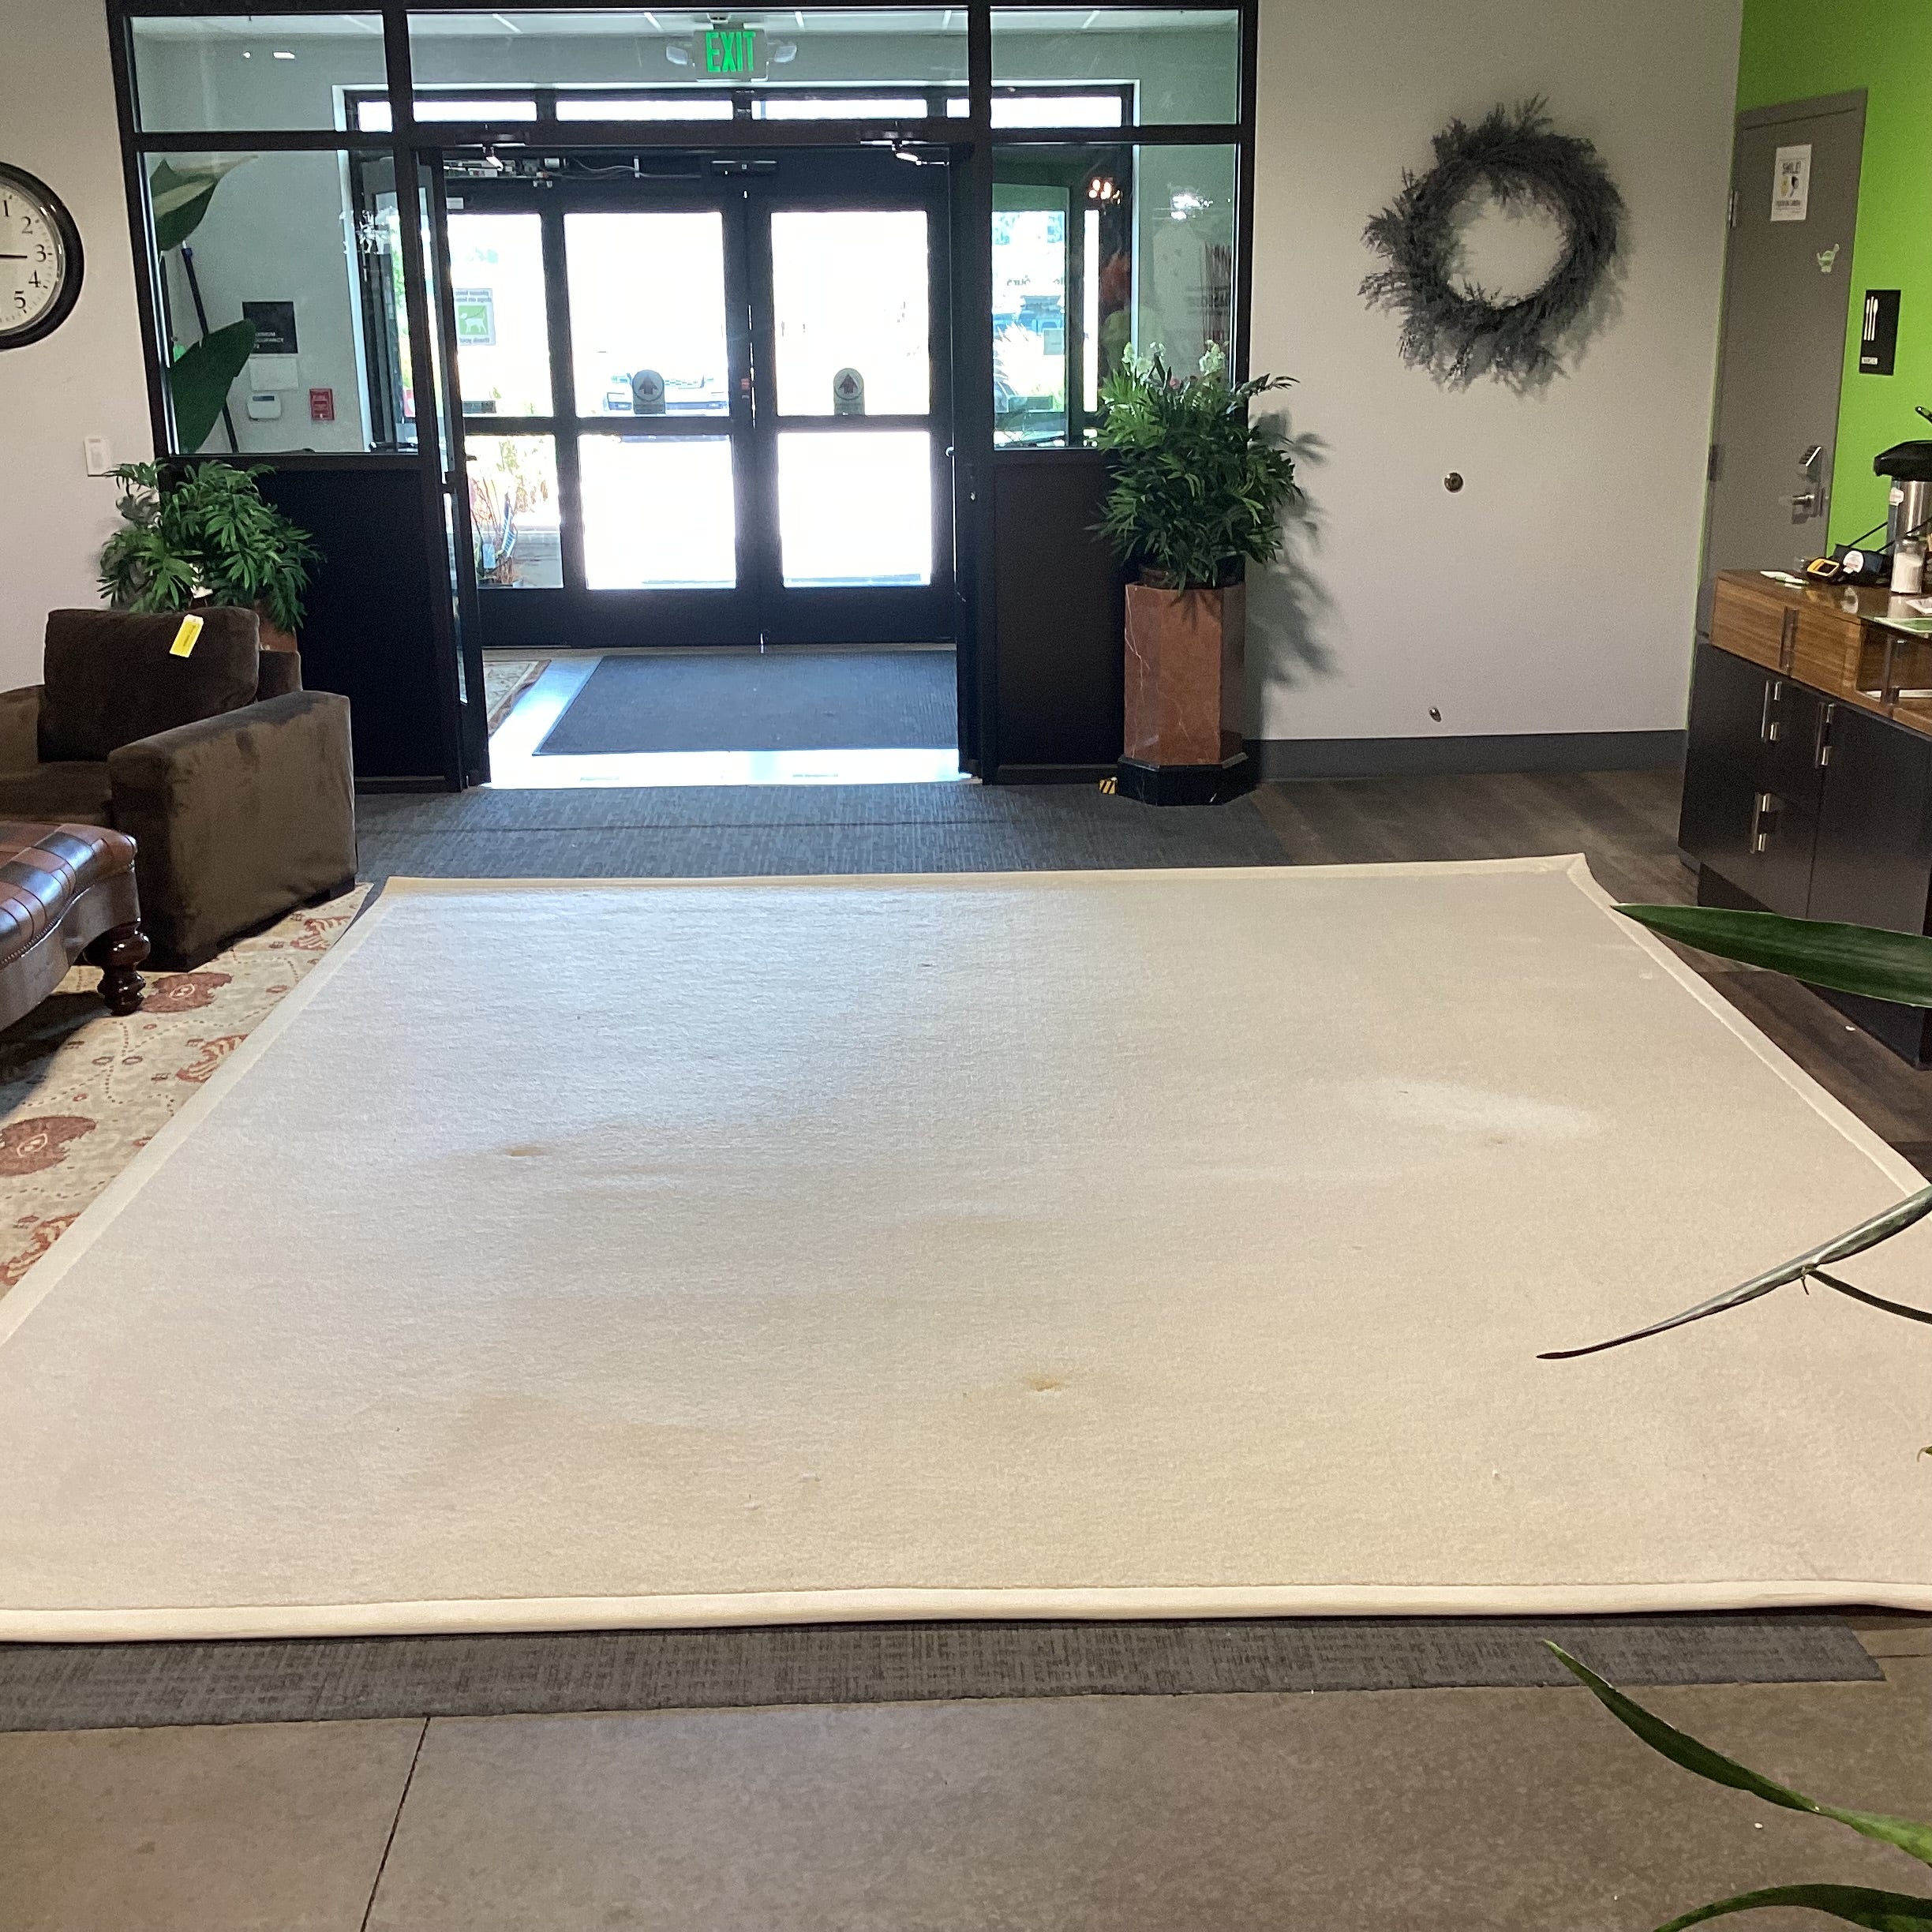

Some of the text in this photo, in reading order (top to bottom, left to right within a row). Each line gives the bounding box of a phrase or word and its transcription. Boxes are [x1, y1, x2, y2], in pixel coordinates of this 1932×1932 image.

[706, 31, 756, 73] EXIT
[3, 199, 9, 218] 1
[21, 215, 33, 234] 2
[33, 244, 47, 263] 3
[28, 269, 41, 288] 4
[13, 290, 26, 309] 5
